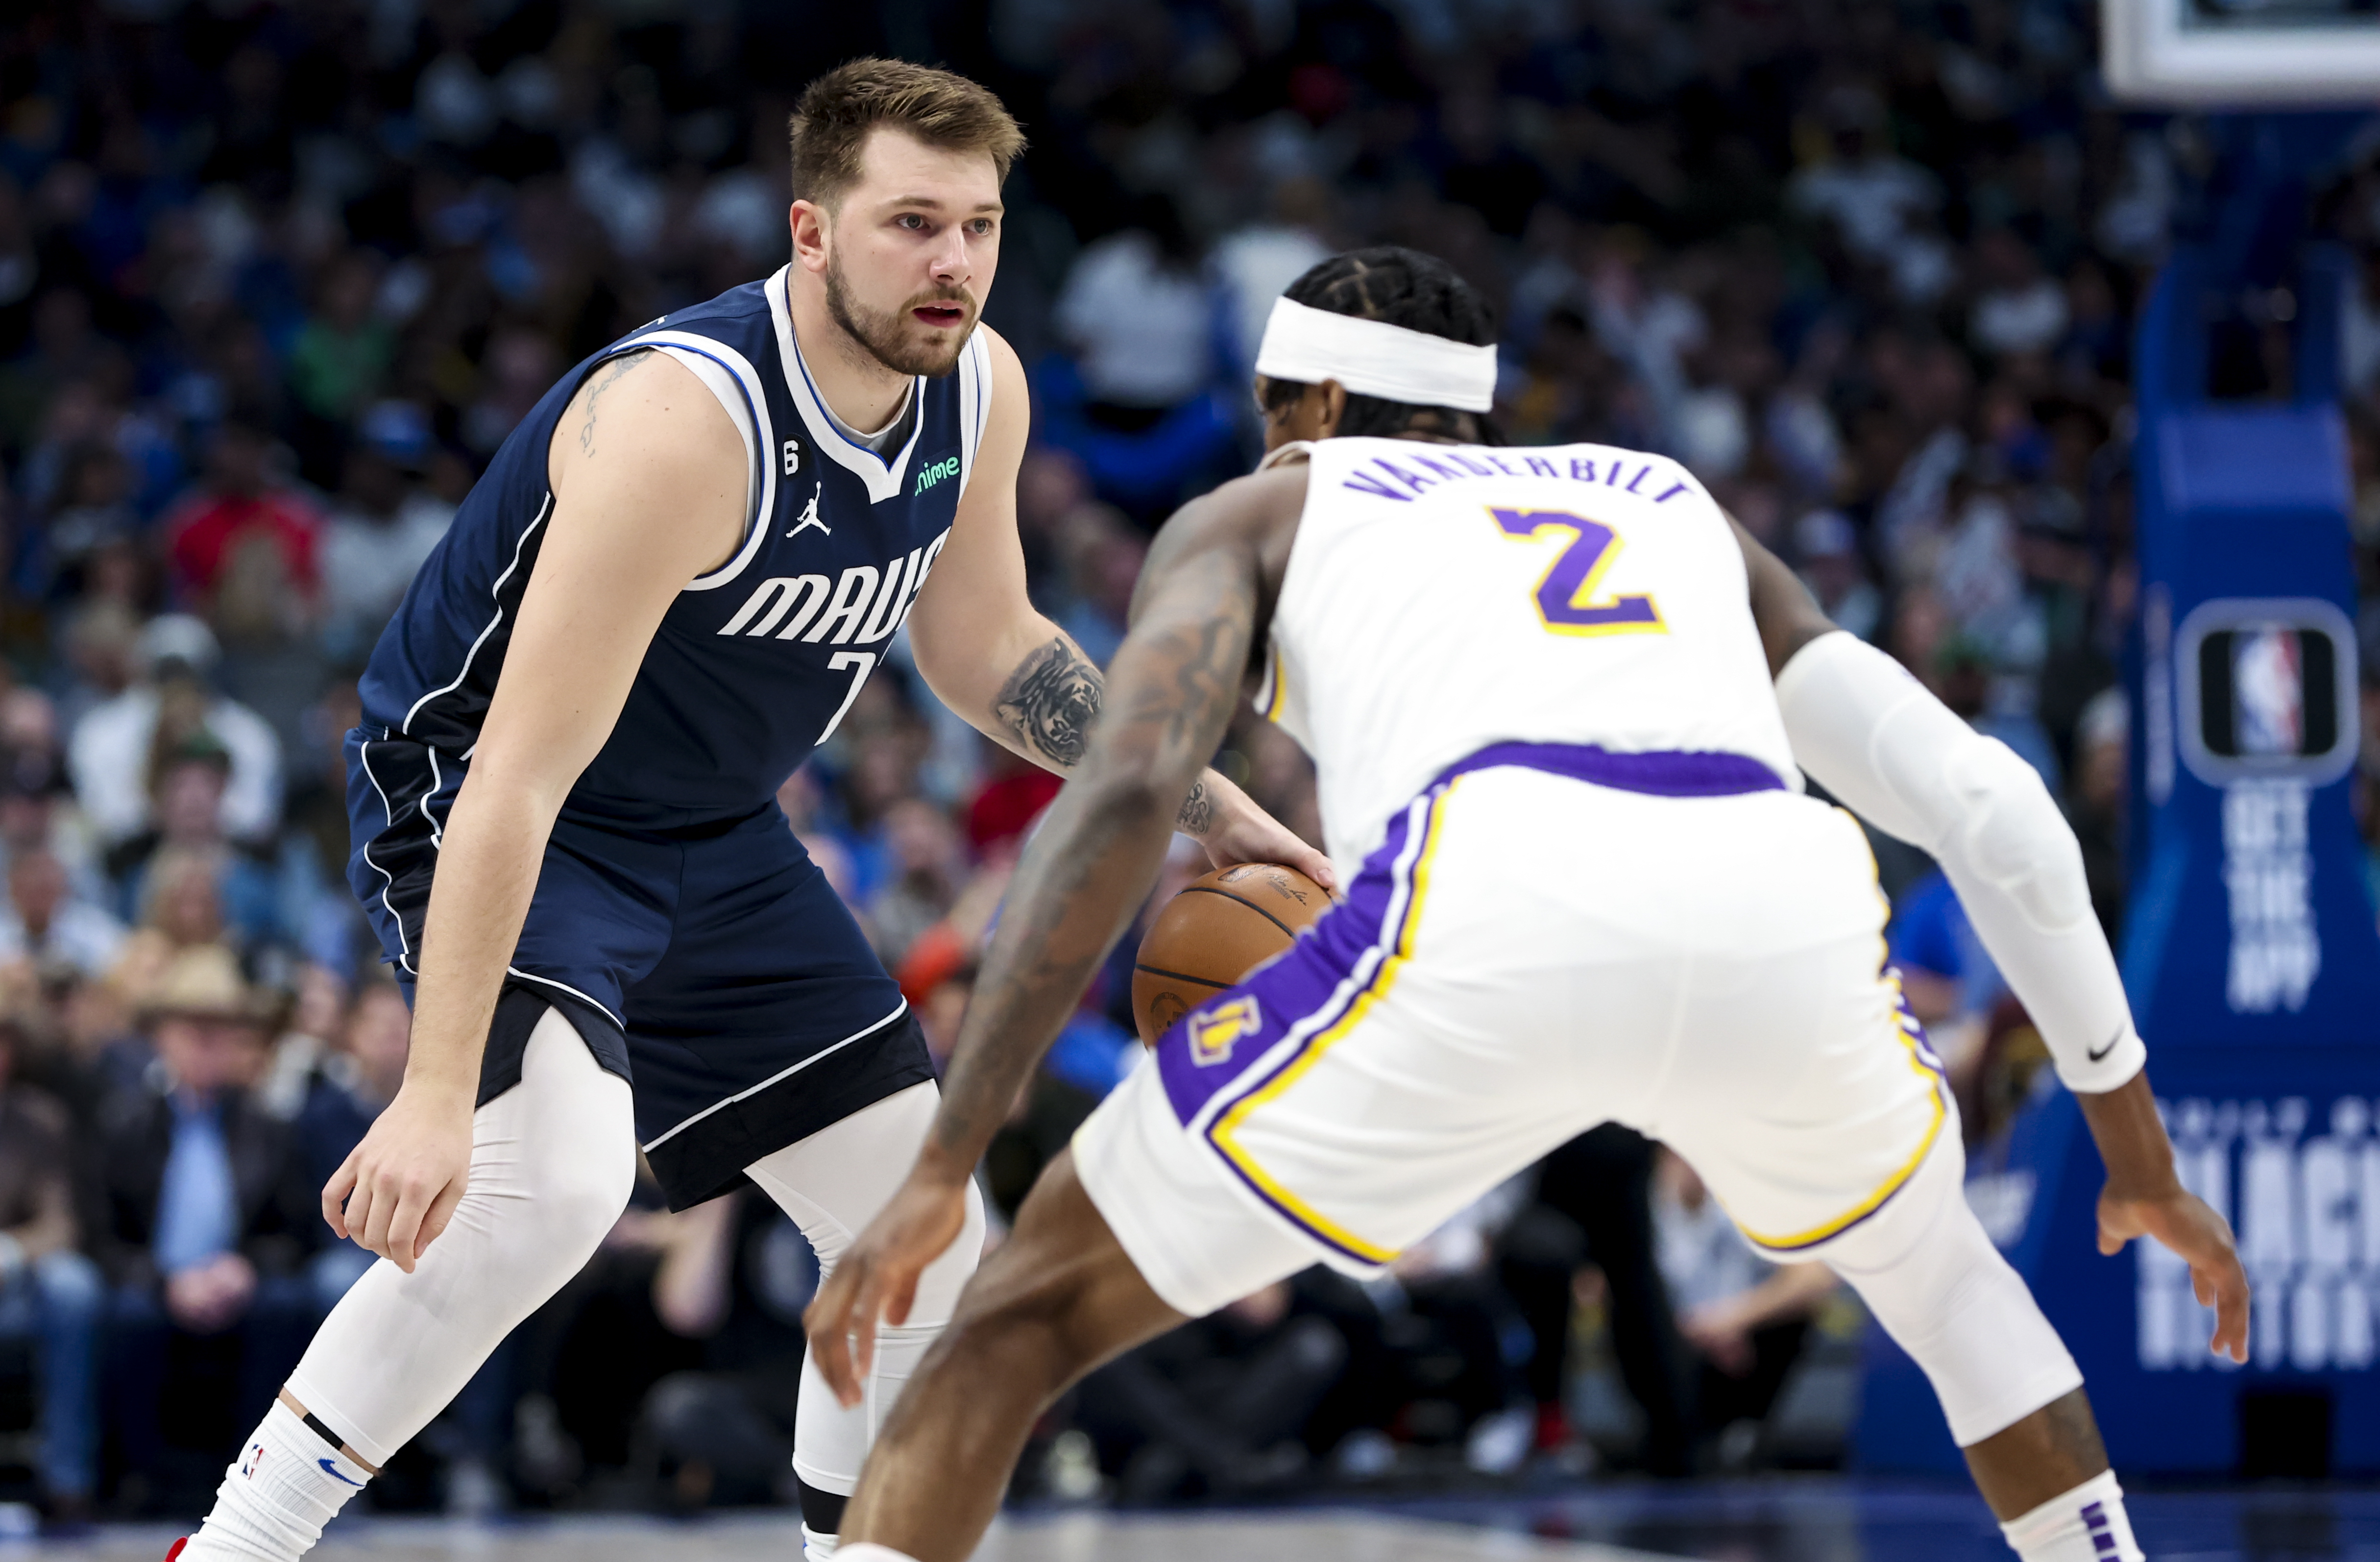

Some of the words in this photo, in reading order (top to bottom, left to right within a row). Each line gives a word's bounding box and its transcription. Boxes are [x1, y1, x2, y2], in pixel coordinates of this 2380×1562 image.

[783, 439, 799, 475] 6
[1342, 452, 1697, 504] VANDERBILT
[1483, 505, 1671, 637] 2
